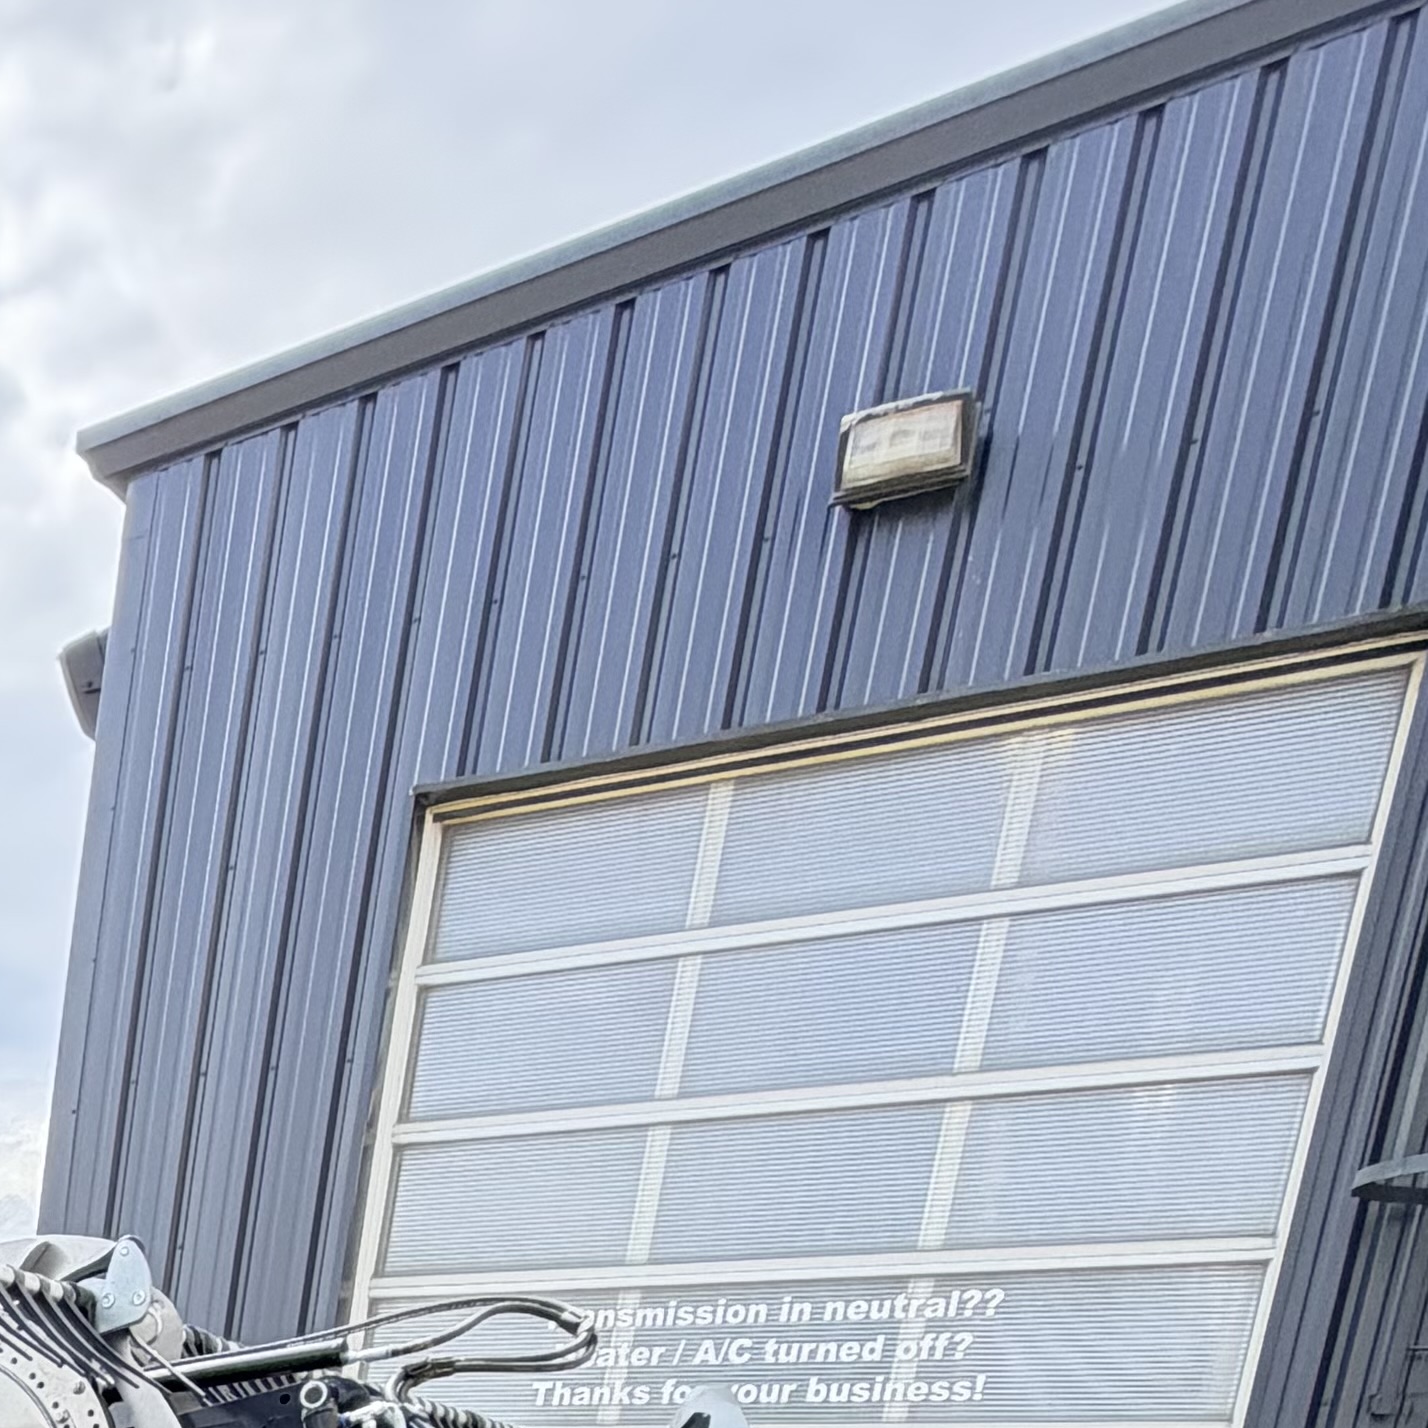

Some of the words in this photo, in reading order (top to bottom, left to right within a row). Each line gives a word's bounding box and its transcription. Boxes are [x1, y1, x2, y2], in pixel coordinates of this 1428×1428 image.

[779, 1296, 812, 1323] in
[824, 1289, 1005, 1321] neutral??
[672, 1340, 687, 1366] /
[693, 1338, 753, 1365] A/C
[764, 1335, 885, 1363] turned
[896, 1332, 973, 1360] off?
[532, 1380, 650, 1407] Thanks
[661, 1379, 697, 1405] fo
[731, 1384, 797, 1404] our
[806, 1374, 986, 1403] business!
